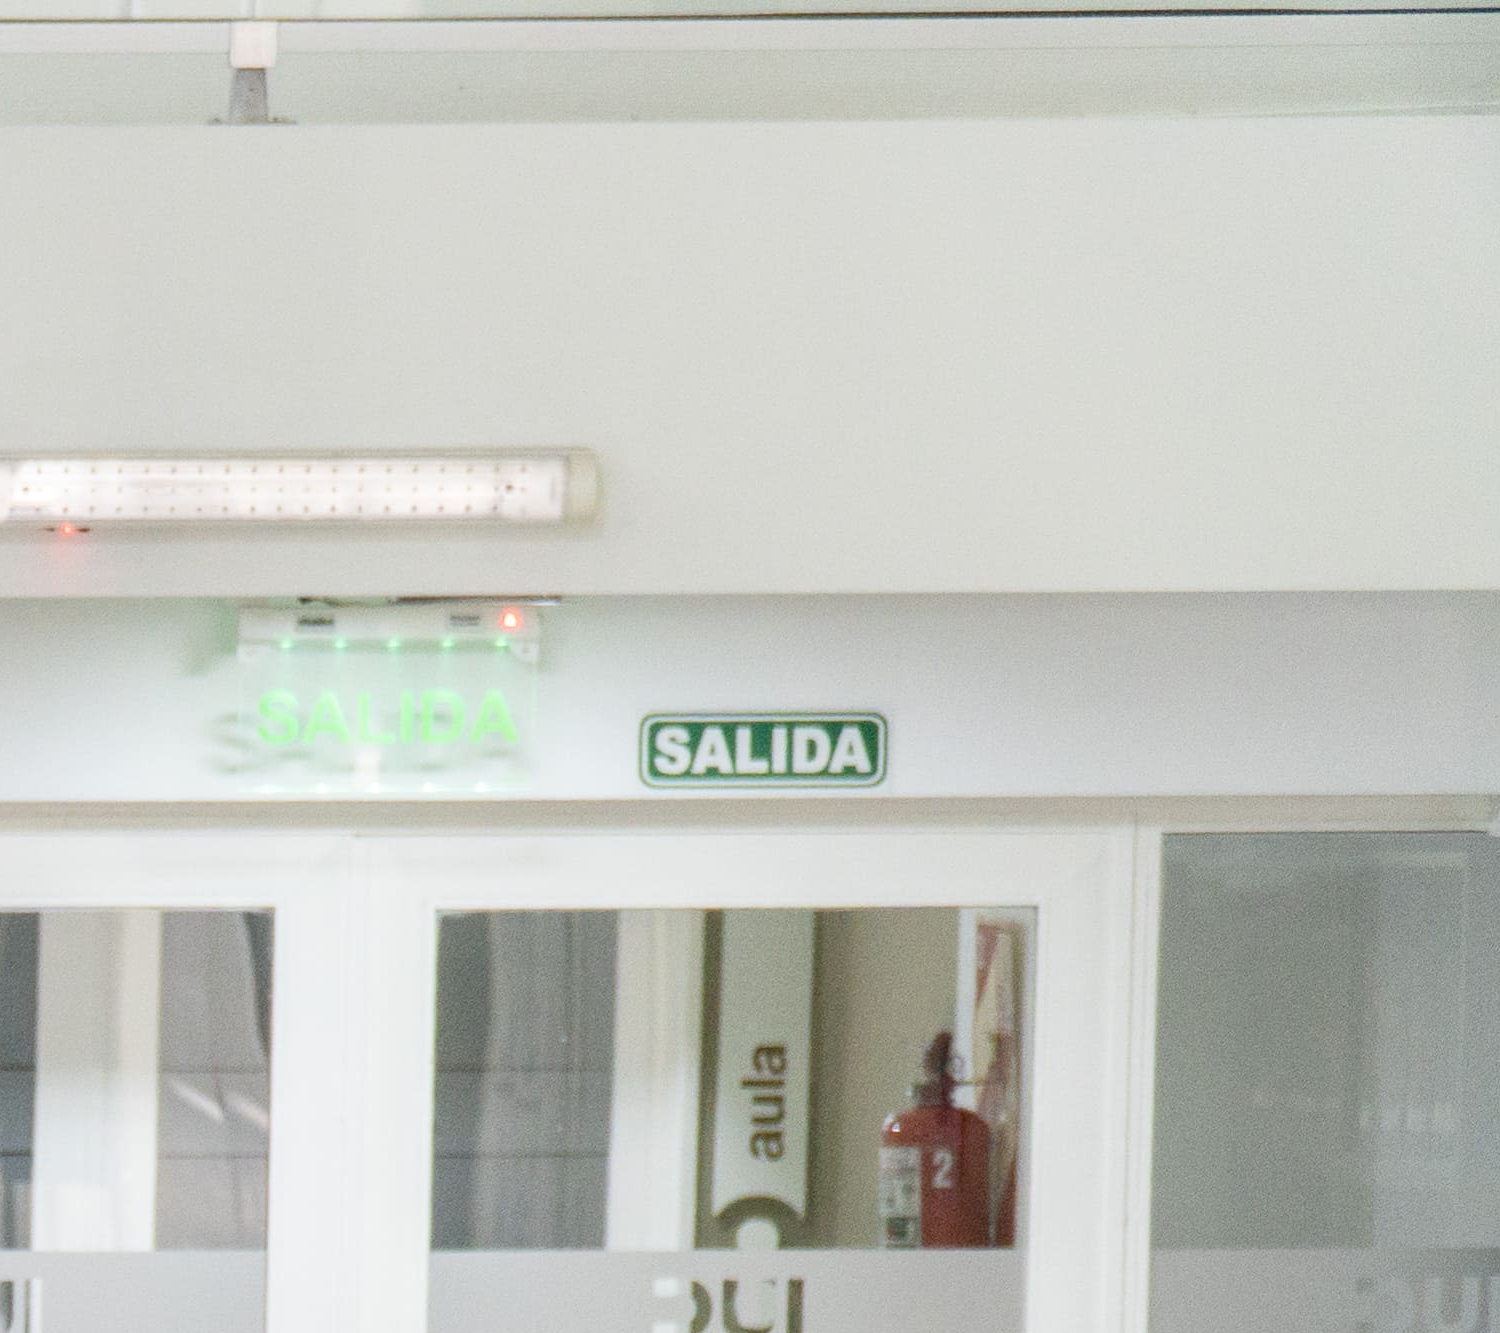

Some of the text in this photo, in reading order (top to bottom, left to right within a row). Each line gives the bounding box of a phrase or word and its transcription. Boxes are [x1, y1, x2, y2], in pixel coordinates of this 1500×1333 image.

[257, 688, 520, 745] SALIDA
[653, 724, 872, 776] SALIDA
[741, 1043, 786, 1162] aula
[931, 1148, 954, 1189] 2
